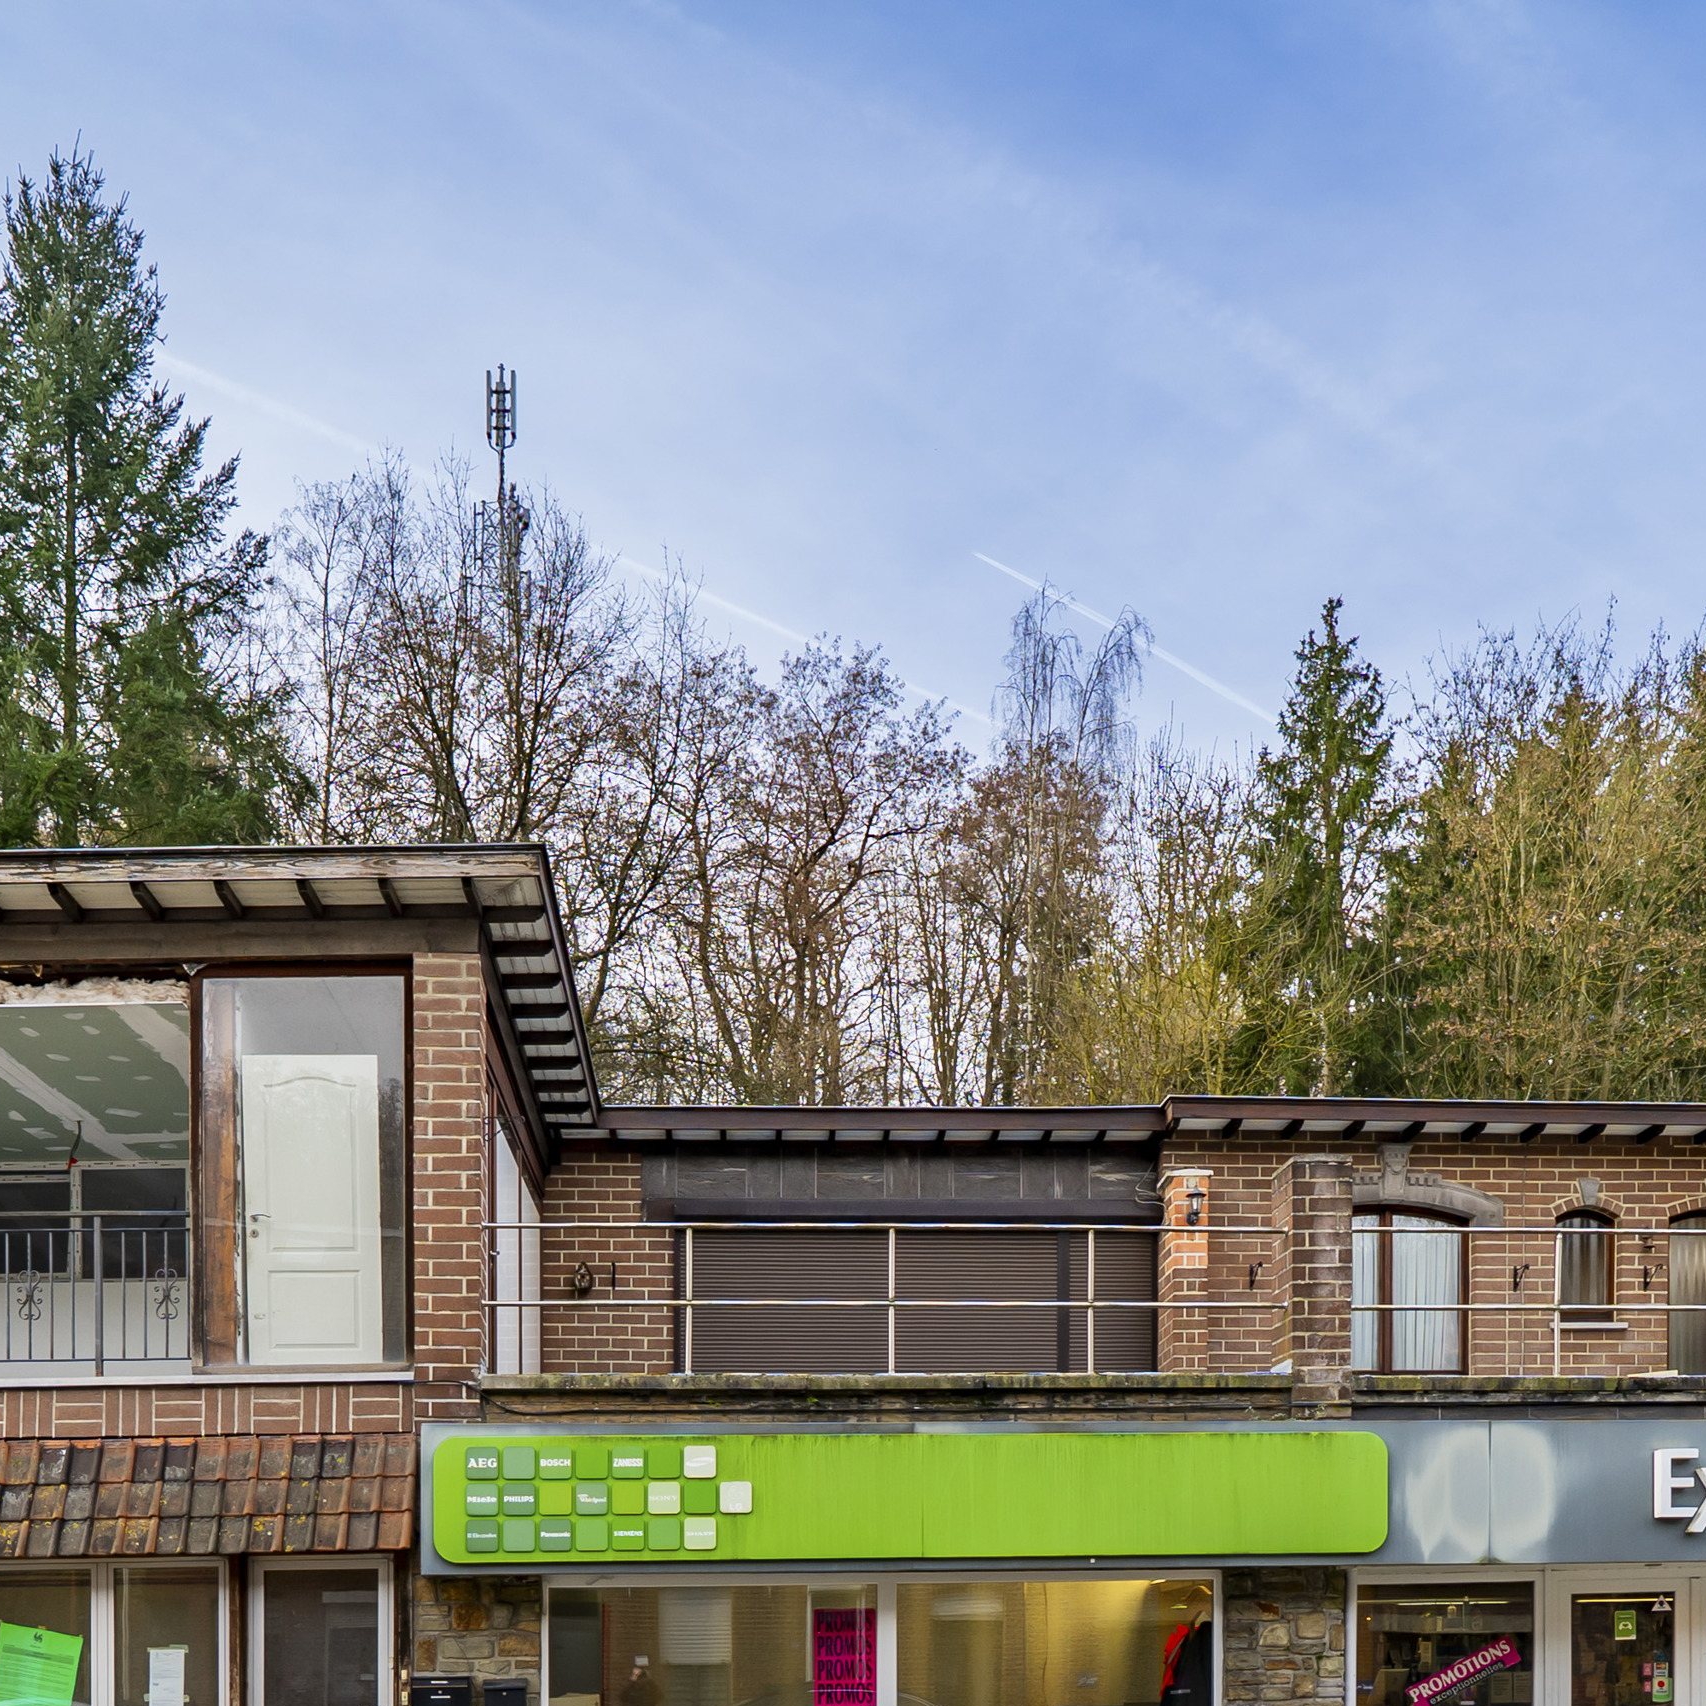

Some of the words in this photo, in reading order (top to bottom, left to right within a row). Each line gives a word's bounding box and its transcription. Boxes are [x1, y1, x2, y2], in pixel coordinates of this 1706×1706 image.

[467, 1458, 498, 1468] AEG
[540, 1459, 571, 1467] BOSCH
[503, 1495, 534, 1503] PHILIPS
[816, 1611, 874, 1633] PROMOS
[816, 1634, 874, 1657] PROMOS
[816, 1658, 874, 1681] PROMOS
[1409, 1640, 1511, 1703] PROMOTIONS
[816, 1682, 874, 1705] PROMOS
[1429, 1661, 1505, 1705] exceptionnelles
